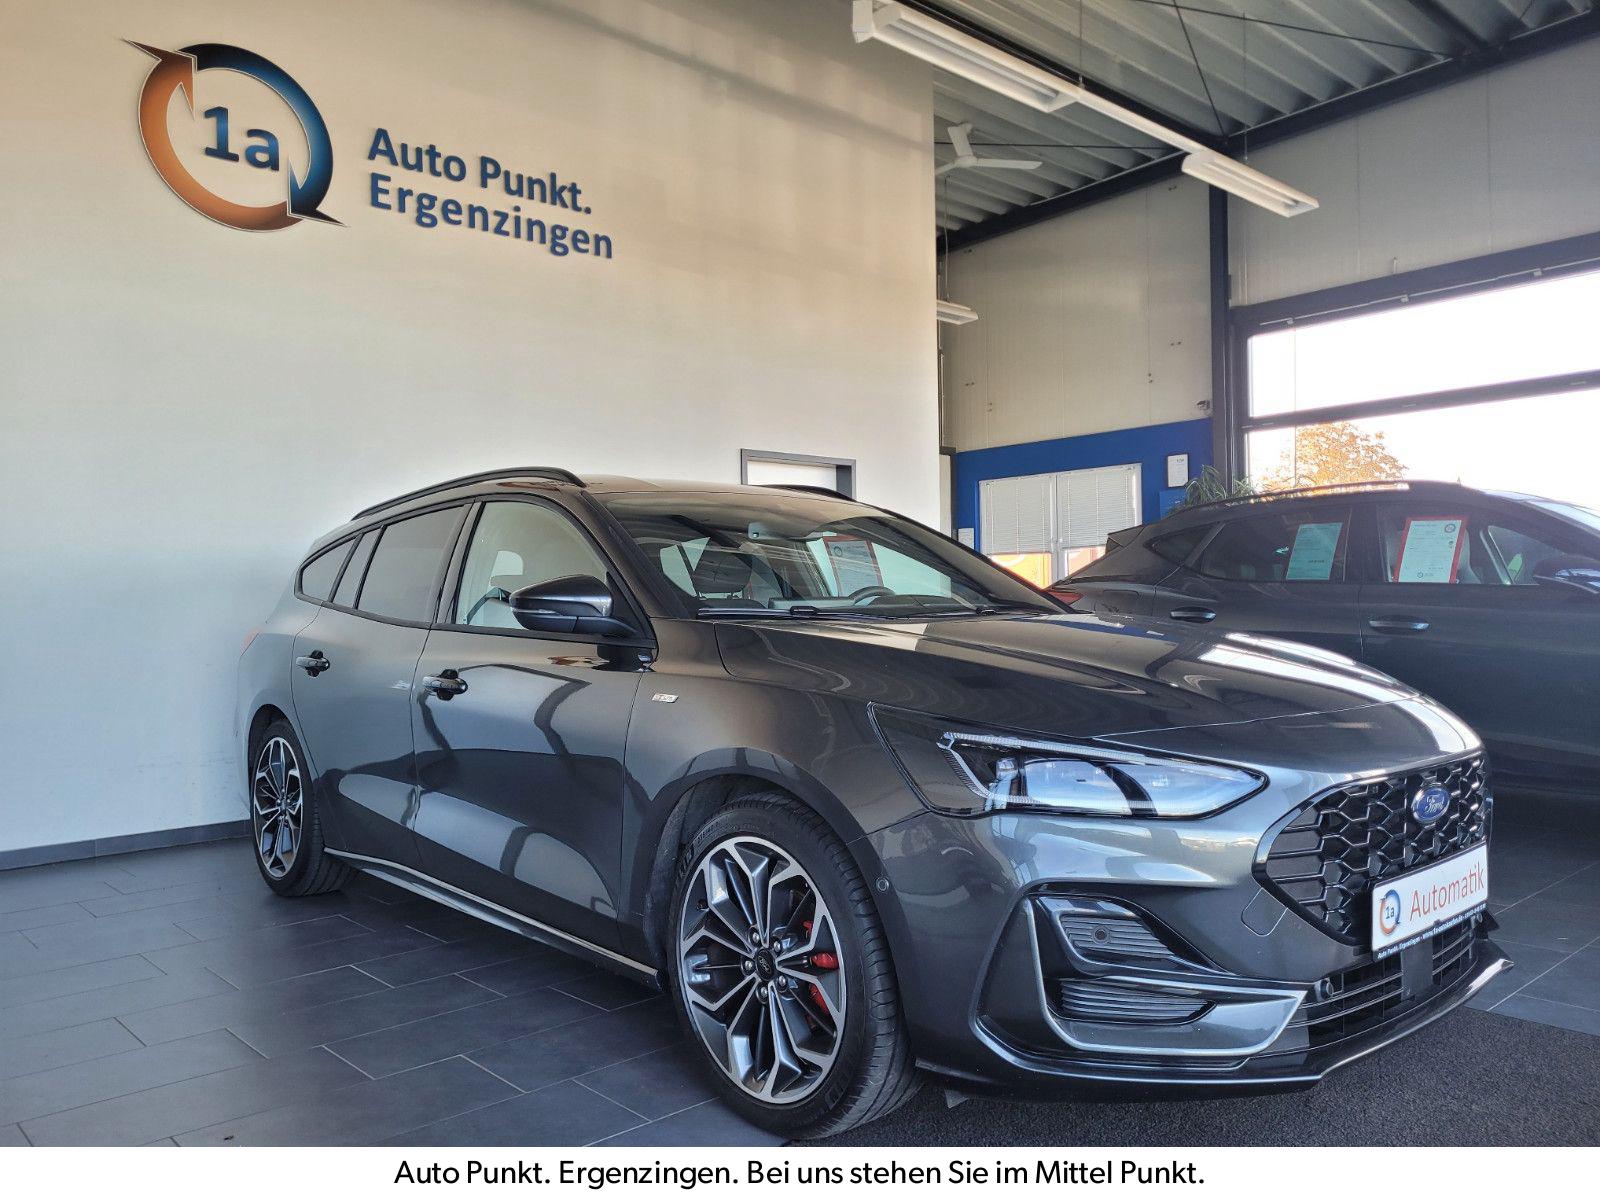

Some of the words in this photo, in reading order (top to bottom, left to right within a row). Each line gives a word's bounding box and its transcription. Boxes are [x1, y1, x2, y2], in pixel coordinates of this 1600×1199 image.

[203, 106, 280, 171] 1a
[367, 127, 467, 181] Auto
[479, 155, 592, 214] Punkt.
[369, 172, 612, 258] Ergenzingen
[1410, 862, 1484, 921] Automatik
